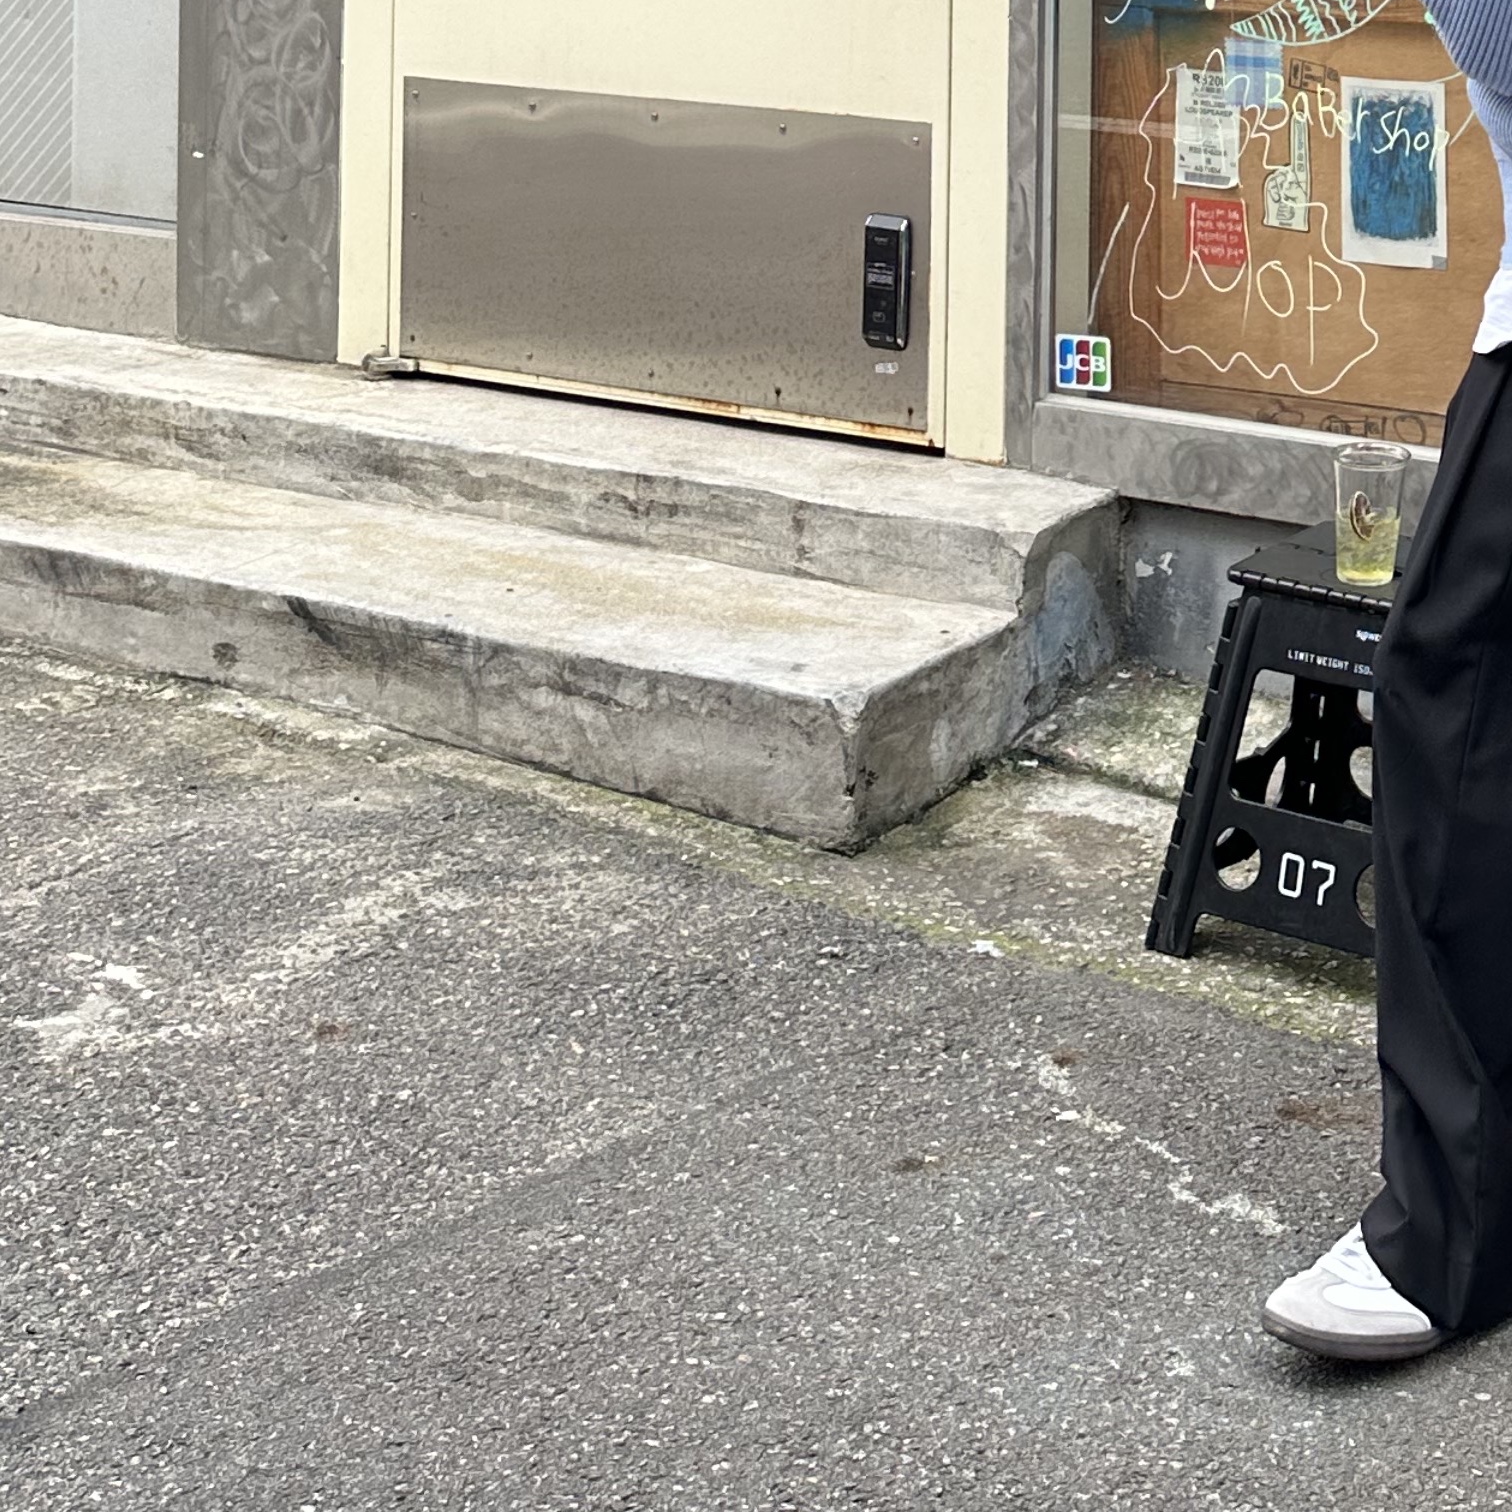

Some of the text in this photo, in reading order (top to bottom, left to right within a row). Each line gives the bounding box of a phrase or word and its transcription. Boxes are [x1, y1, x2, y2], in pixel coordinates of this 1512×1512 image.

[1058, 353, 1106, 373] JCB
[1287, 648, 1316, 664] LIMIT
[1315, 655, 1350, 671] WEIGHT
[1277, 851, 1337, 907] 07
